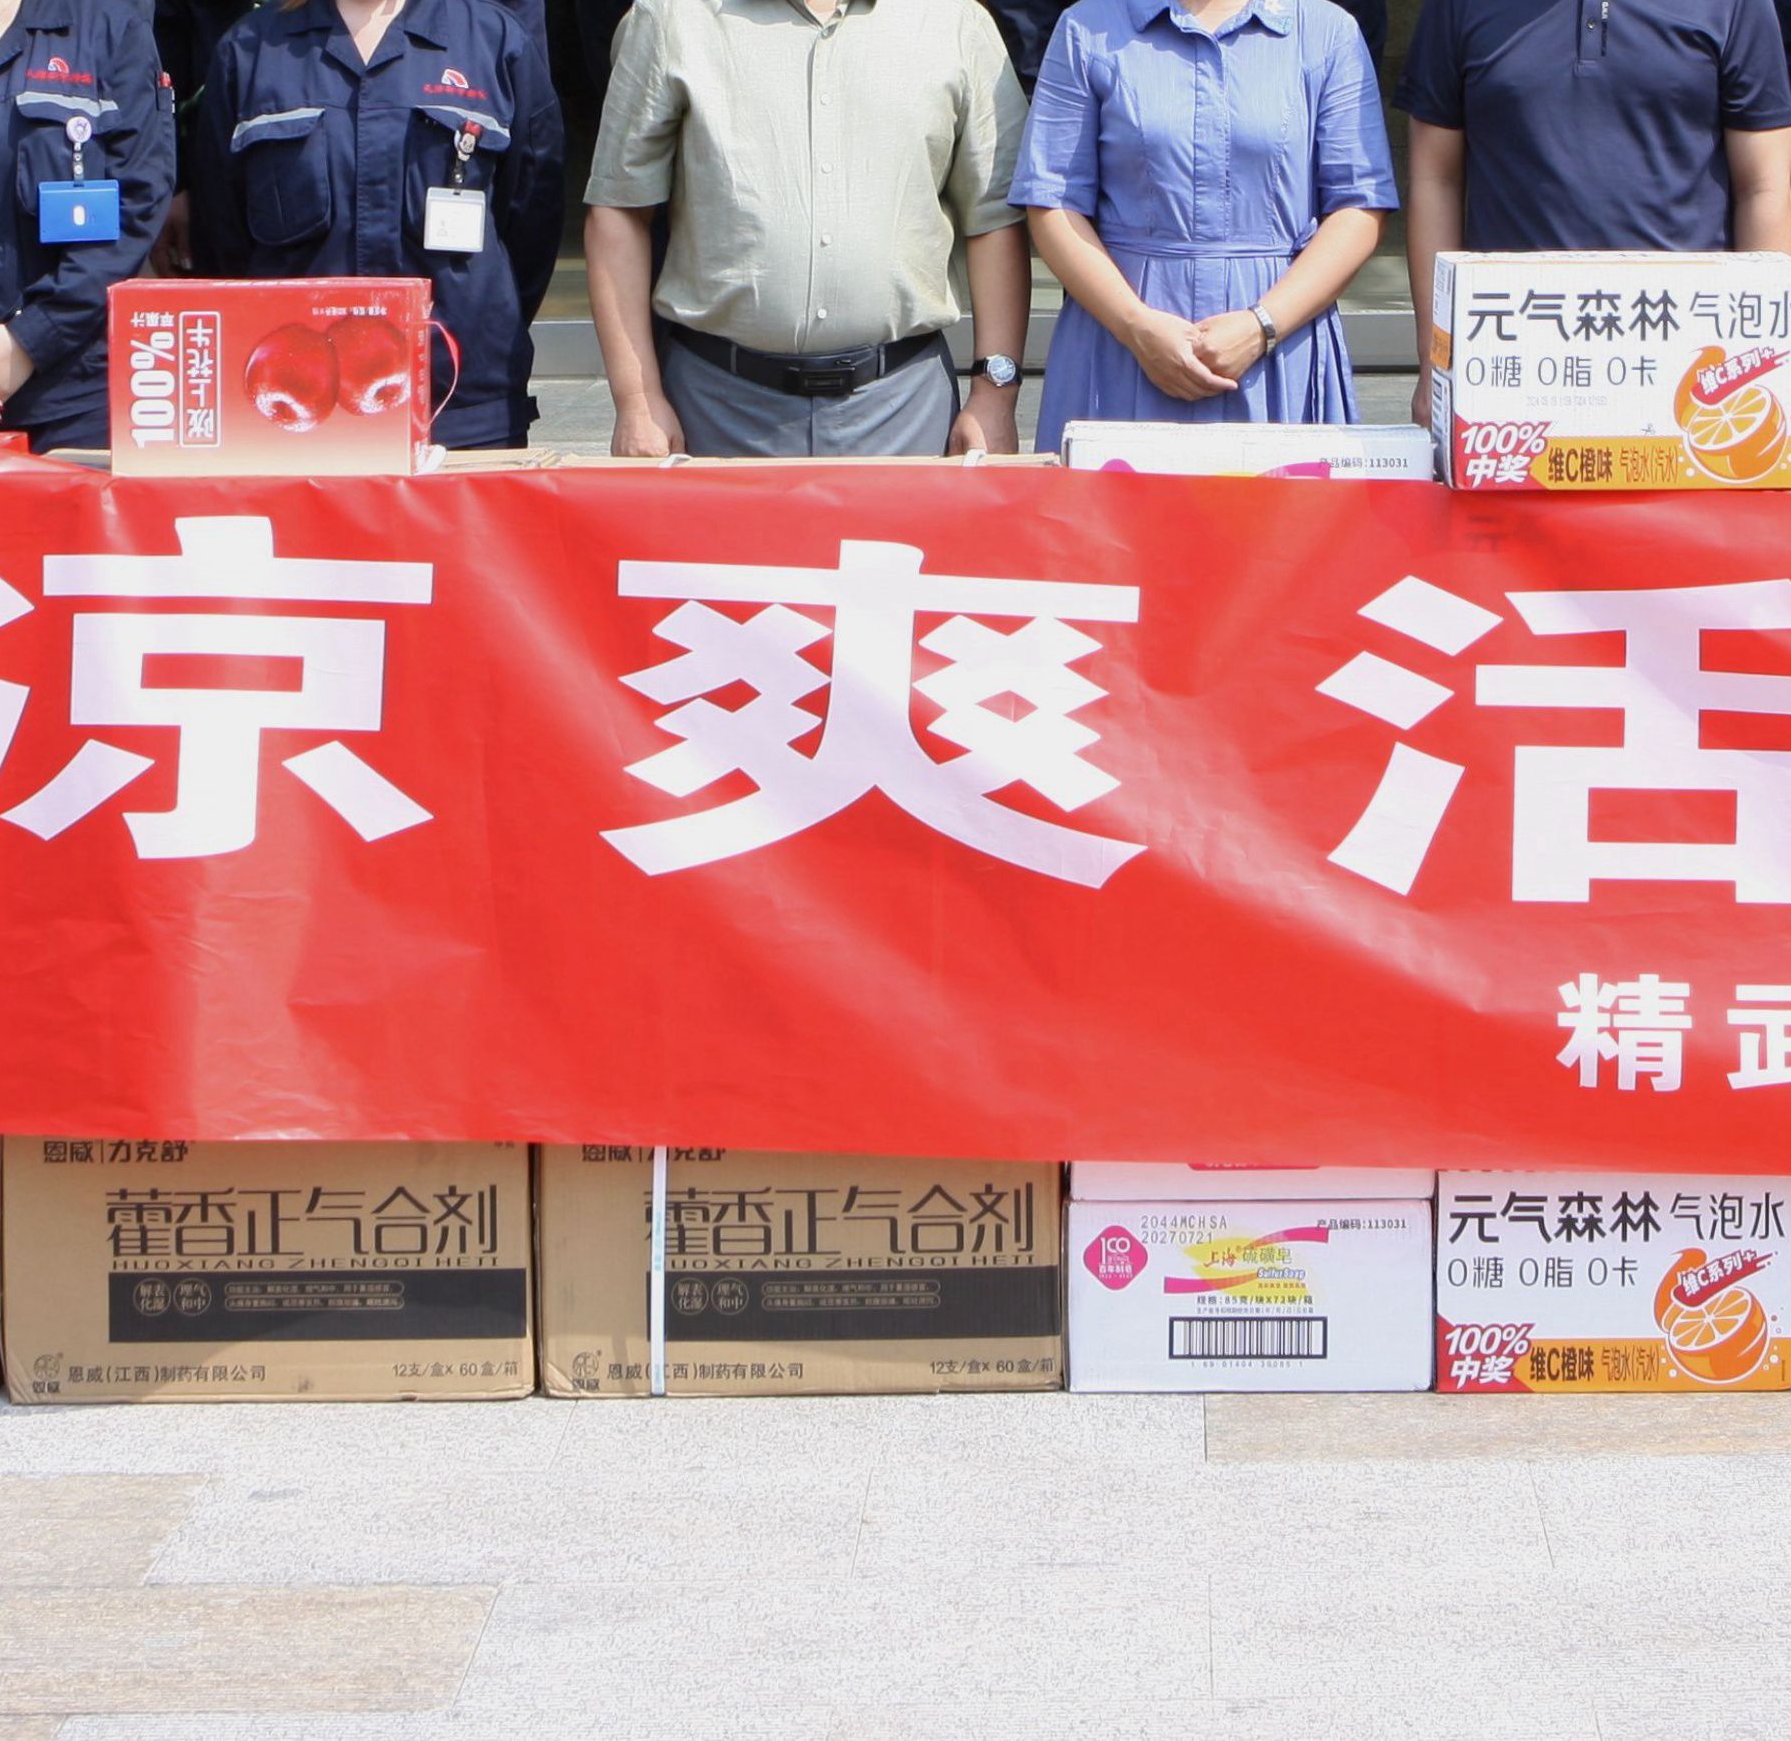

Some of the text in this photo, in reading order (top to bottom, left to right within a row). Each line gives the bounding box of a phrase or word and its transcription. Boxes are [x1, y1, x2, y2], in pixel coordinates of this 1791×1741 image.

[1466, 289, 1681, 342] 元气森林
[129, 331, 176, 449] 100%
[1461, 423, 1548, 455] 100%
[1466, 454, 1532, 487] 中奖
[1547, 447, 1613, 483] 维C橙味
[105, 1184, 498, 1257] 藿香正气合剂
[644, 1182, 1034, 1256] 藿香正气合剂
[1448, 1190, 1785, 1244] 元气森林 气泡水
[1141, 1231, 1213, 1244] 20270721
[112, 1257, 500, 1271] HUOXIANG ZHENGQI HEJI
[670, 1254, 1036, 1270] UOXIANG ZHENGQI HEJI
[1445, 1323, 1531, 1356] 100%
[1450, 1356, 1515, 1389] 中奖
[1529, 1346, 1595, 1382] 维C橙味
